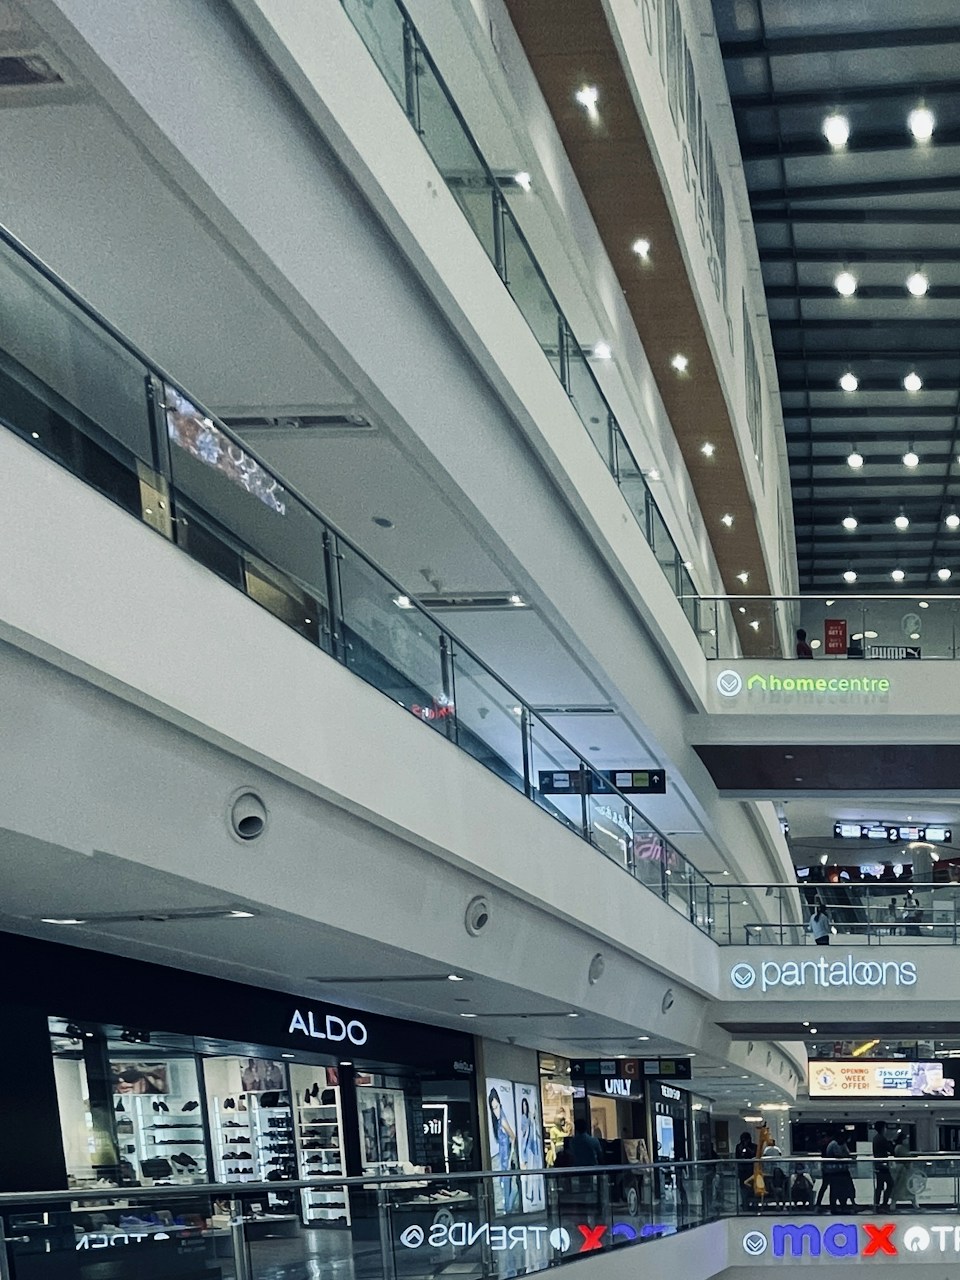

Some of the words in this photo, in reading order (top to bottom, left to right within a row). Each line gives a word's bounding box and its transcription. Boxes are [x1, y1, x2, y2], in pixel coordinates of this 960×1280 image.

[769, 673, 890, 692] homecentre
[889, 829, 898, 840] 2
[761, 955, 917, 992] pantaloons
[288, 1009, 368, 1047] ALDO
[624, 1062, 635, 1074] G
[604, 1079, 632, 1096] ONLY
[772, 1223, 898, 1258] max
